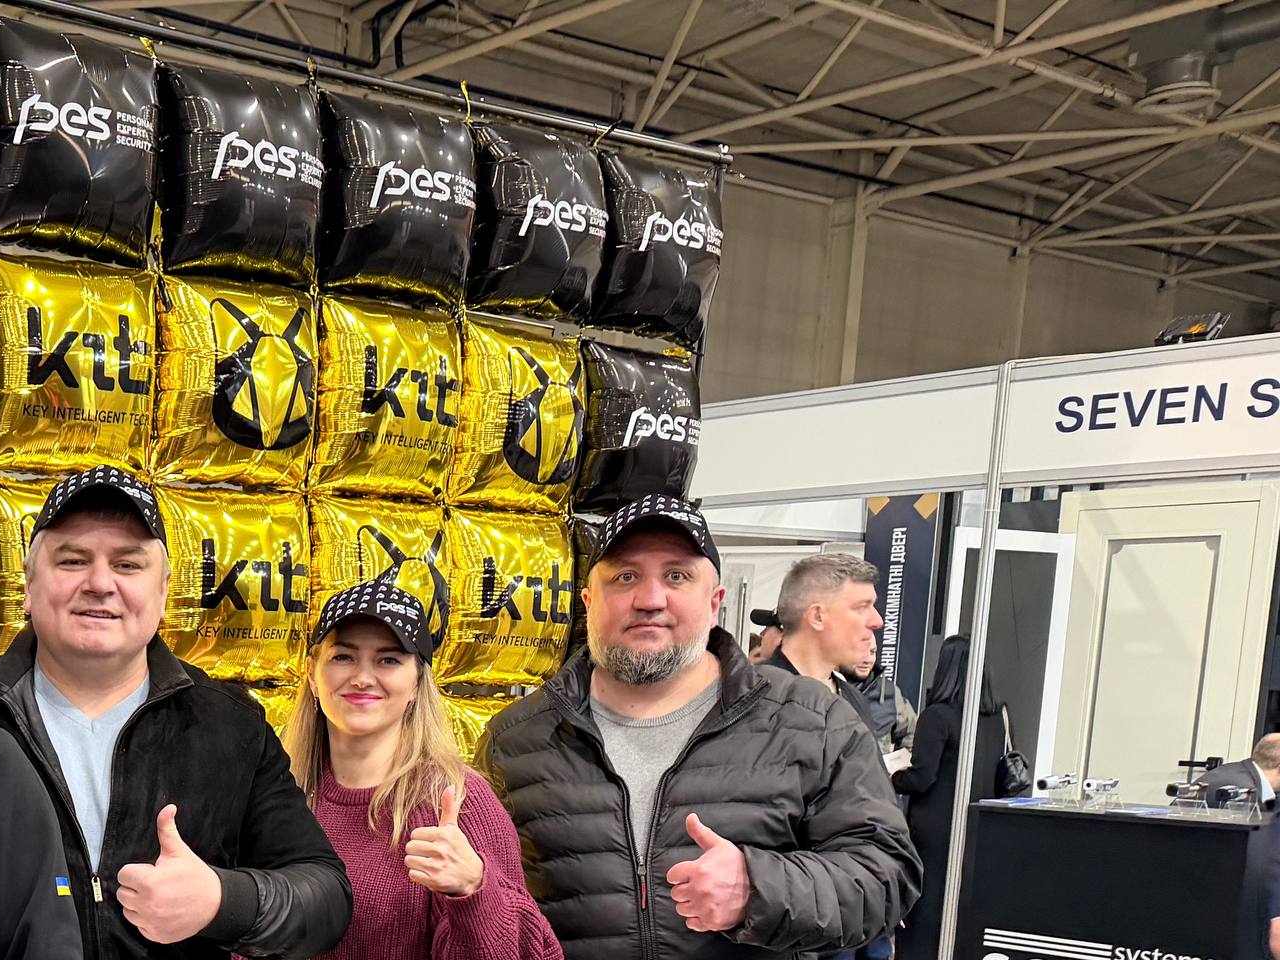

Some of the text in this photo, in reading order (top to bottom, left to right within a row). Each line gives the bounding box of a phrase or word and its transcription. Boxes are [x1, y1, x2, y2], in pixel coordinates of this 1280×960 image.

[13, 94, 112, 144] pes
[116, 136, 152, 151] SECURITY
[211, 131, 299, 179] pes
[370, 161, 453, 208] pes
[518, 194, 588, 236] pes
[638, 211, 706, 252] pes
[22, 404, 49, 417] KEY
[52, 407, 126, 424] INTELLIGENT
[622, 406, 688, 447] pes
[1055, 382, 1228, 433] SEVEN
[355, 432, 379, 444] KEY
[380, 434, 438, 451] INTELLIGENT
[890, 527, 907, 562] ДВЕРІ
[882, 565, 904, 644] МІЖКІМНАТНІ
[196, 626, 221, 639] KEY
[223, 627, 287, 640] INTELLIGENT
[474, 632, 497, 645] KEY
[498, 635, 552, 648] INTELLIGENT
